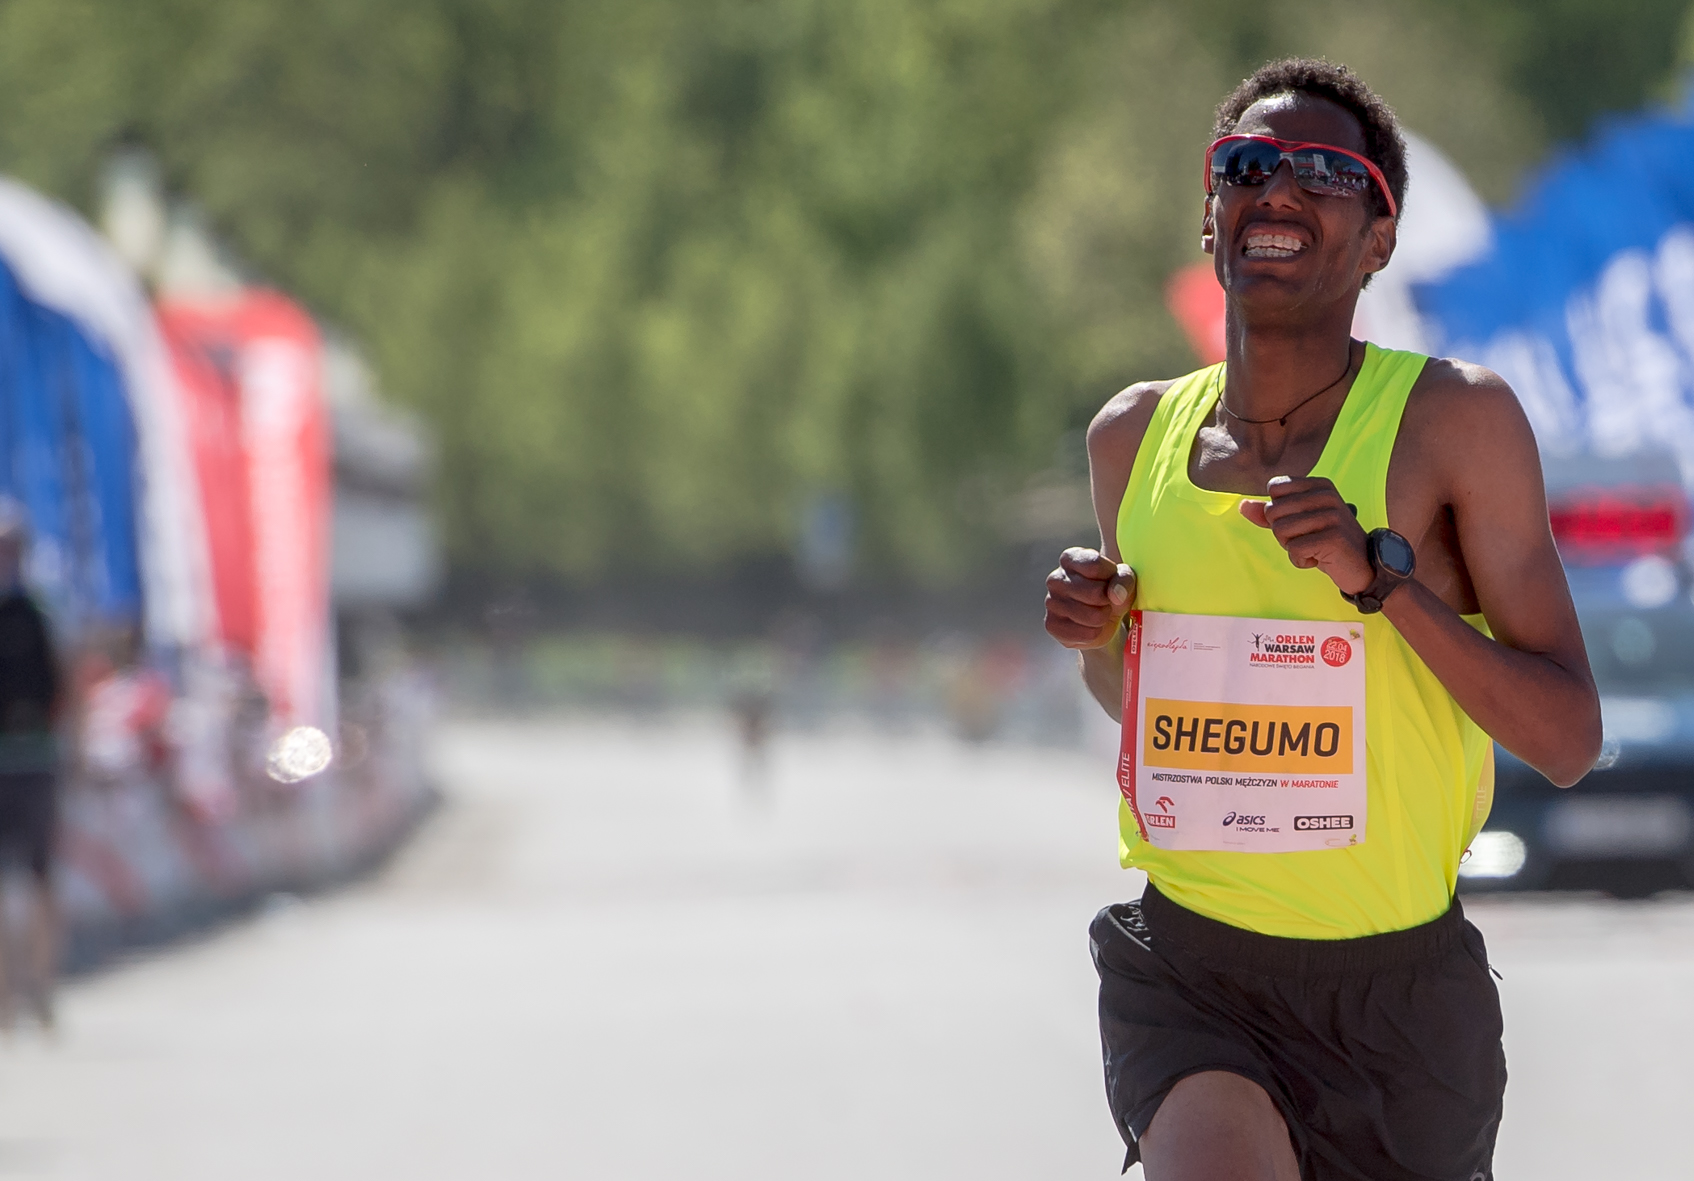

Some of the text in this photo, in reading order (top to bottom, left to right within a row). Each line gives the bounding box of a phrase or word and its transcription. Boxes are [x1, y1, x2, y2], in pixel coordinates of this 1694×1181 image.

[1276, 635, 1315, 644] ORLEN
[1264, 644, 1315, 653] WARSAW
[1250, 653, 1315, 663] MARATHON
[1323, 650, 1346, 663] 2018
[1153, 714, 1340, 757] SHEGUMO
[1121, 752, 1131, 788] ELITE
[1152, 773, 1339, 788] MISTRZOSTWA POLSKI MĘŻCZYZN W MARATONIE
[1236, 815, 1266, 825] asics
[1296, 816, 1351, 829] OSHEE
